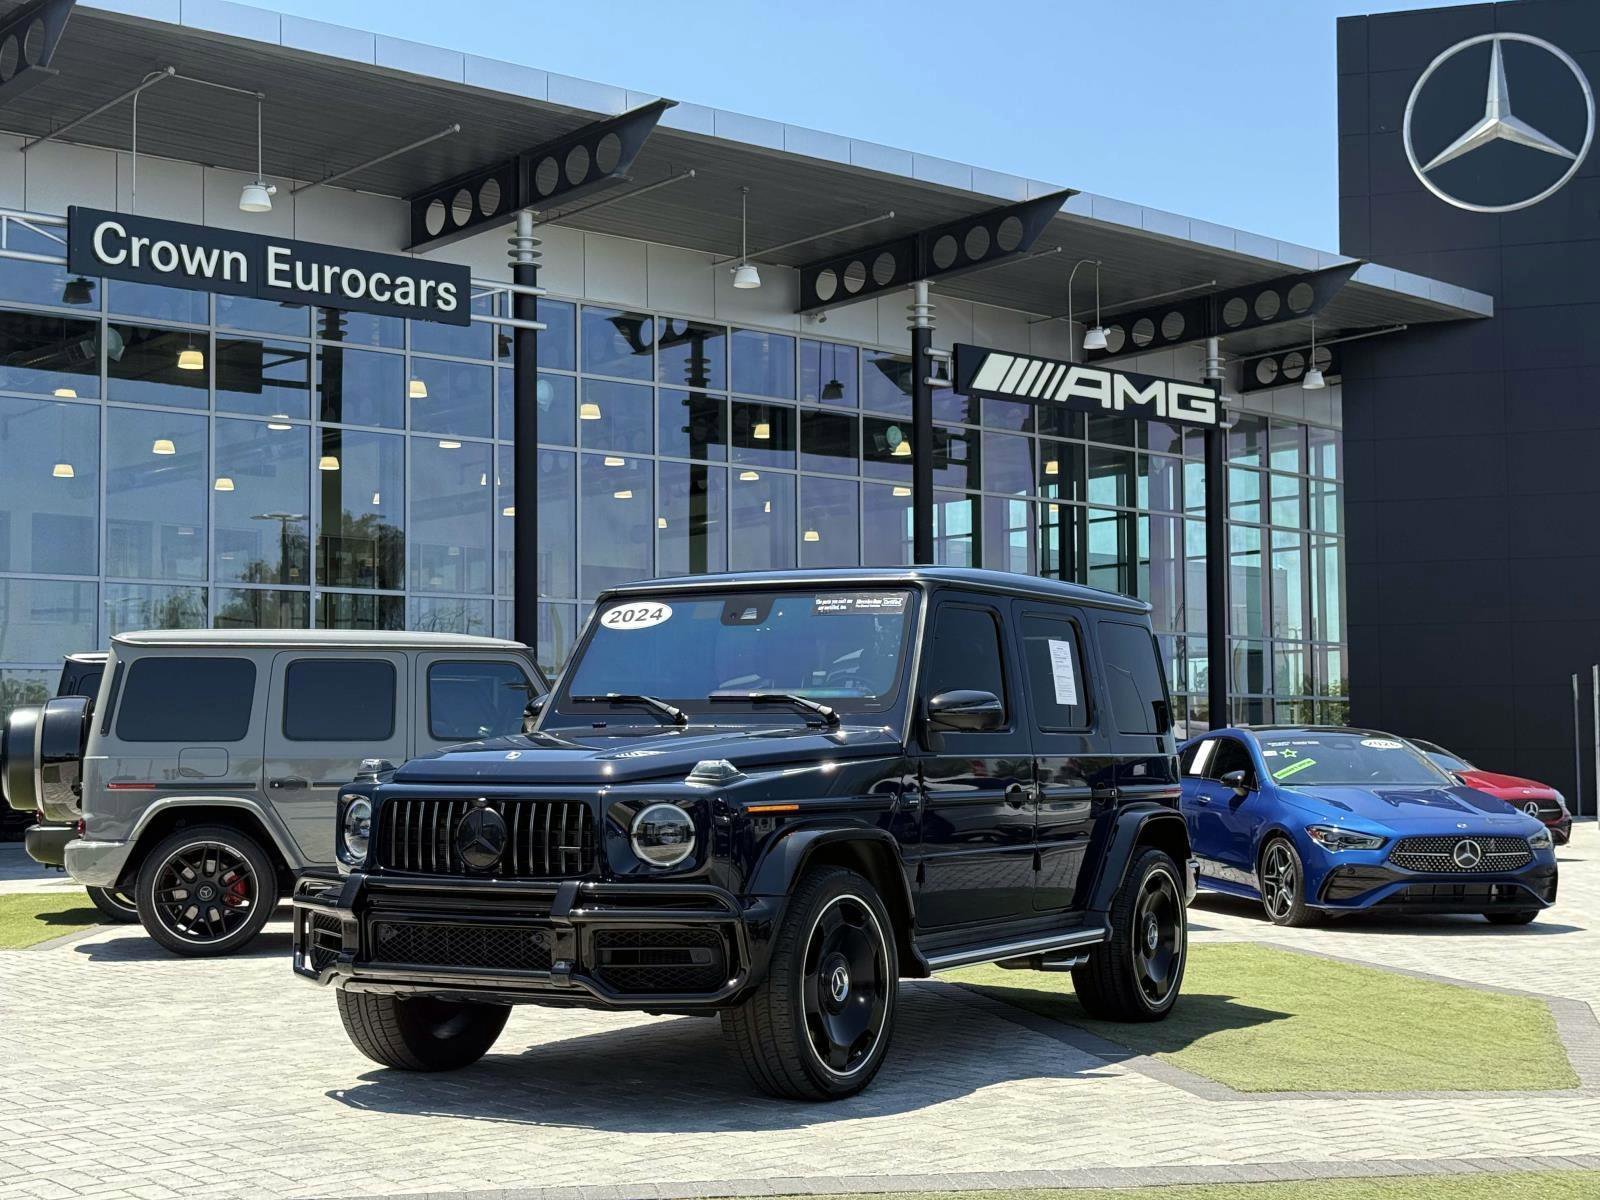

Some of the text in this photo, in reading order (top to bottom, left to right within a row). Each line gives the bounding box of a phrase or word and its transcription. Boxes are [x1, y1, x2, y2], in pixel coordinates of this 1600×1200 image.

[93, 221, 458, 312] Crown Eurocars
[1054, 366, 1216, 424] AMG
[608, 607, 664, 624] 2024
